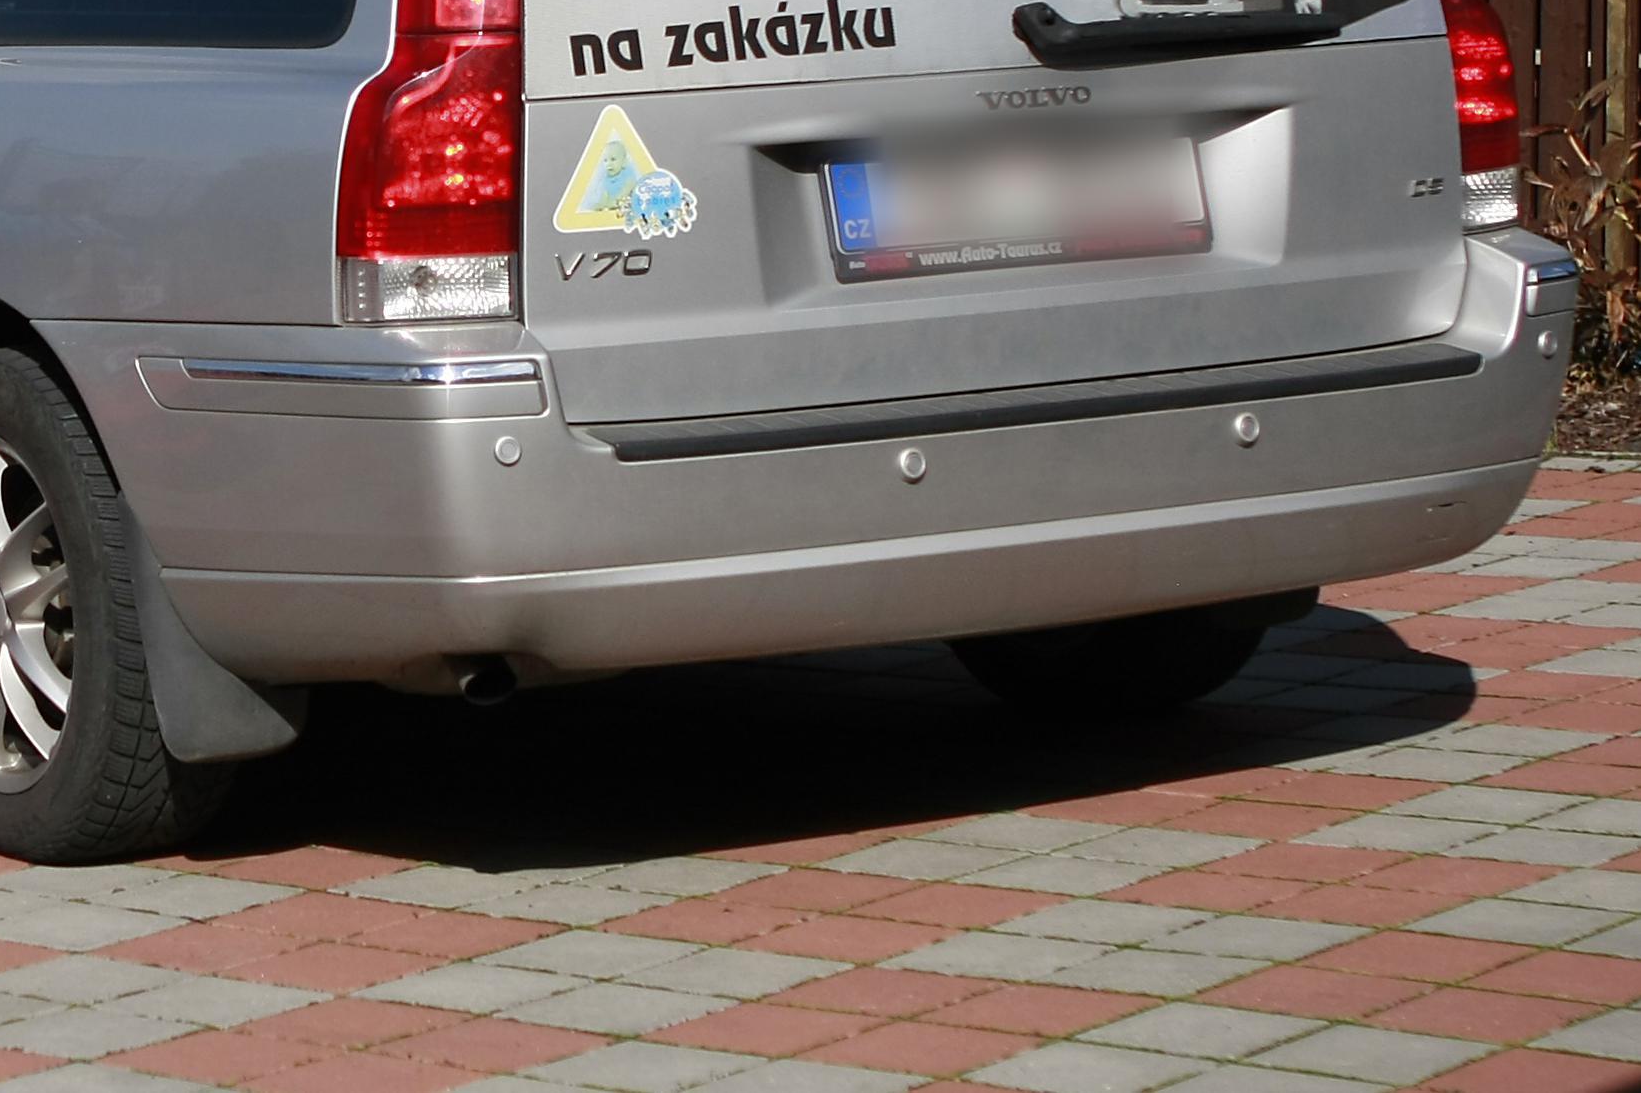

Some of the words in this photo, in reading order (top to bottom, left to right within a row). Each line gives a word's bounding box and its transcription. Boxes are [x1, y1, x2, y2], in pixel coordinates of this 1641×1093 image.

[569, 25, 644, 77] na
[975, 86, 1092, 110] VOLVO
[844, 218, 871, 239] CZ
[919, 242, 1063, 265] www.Auto-Taurus.cz
